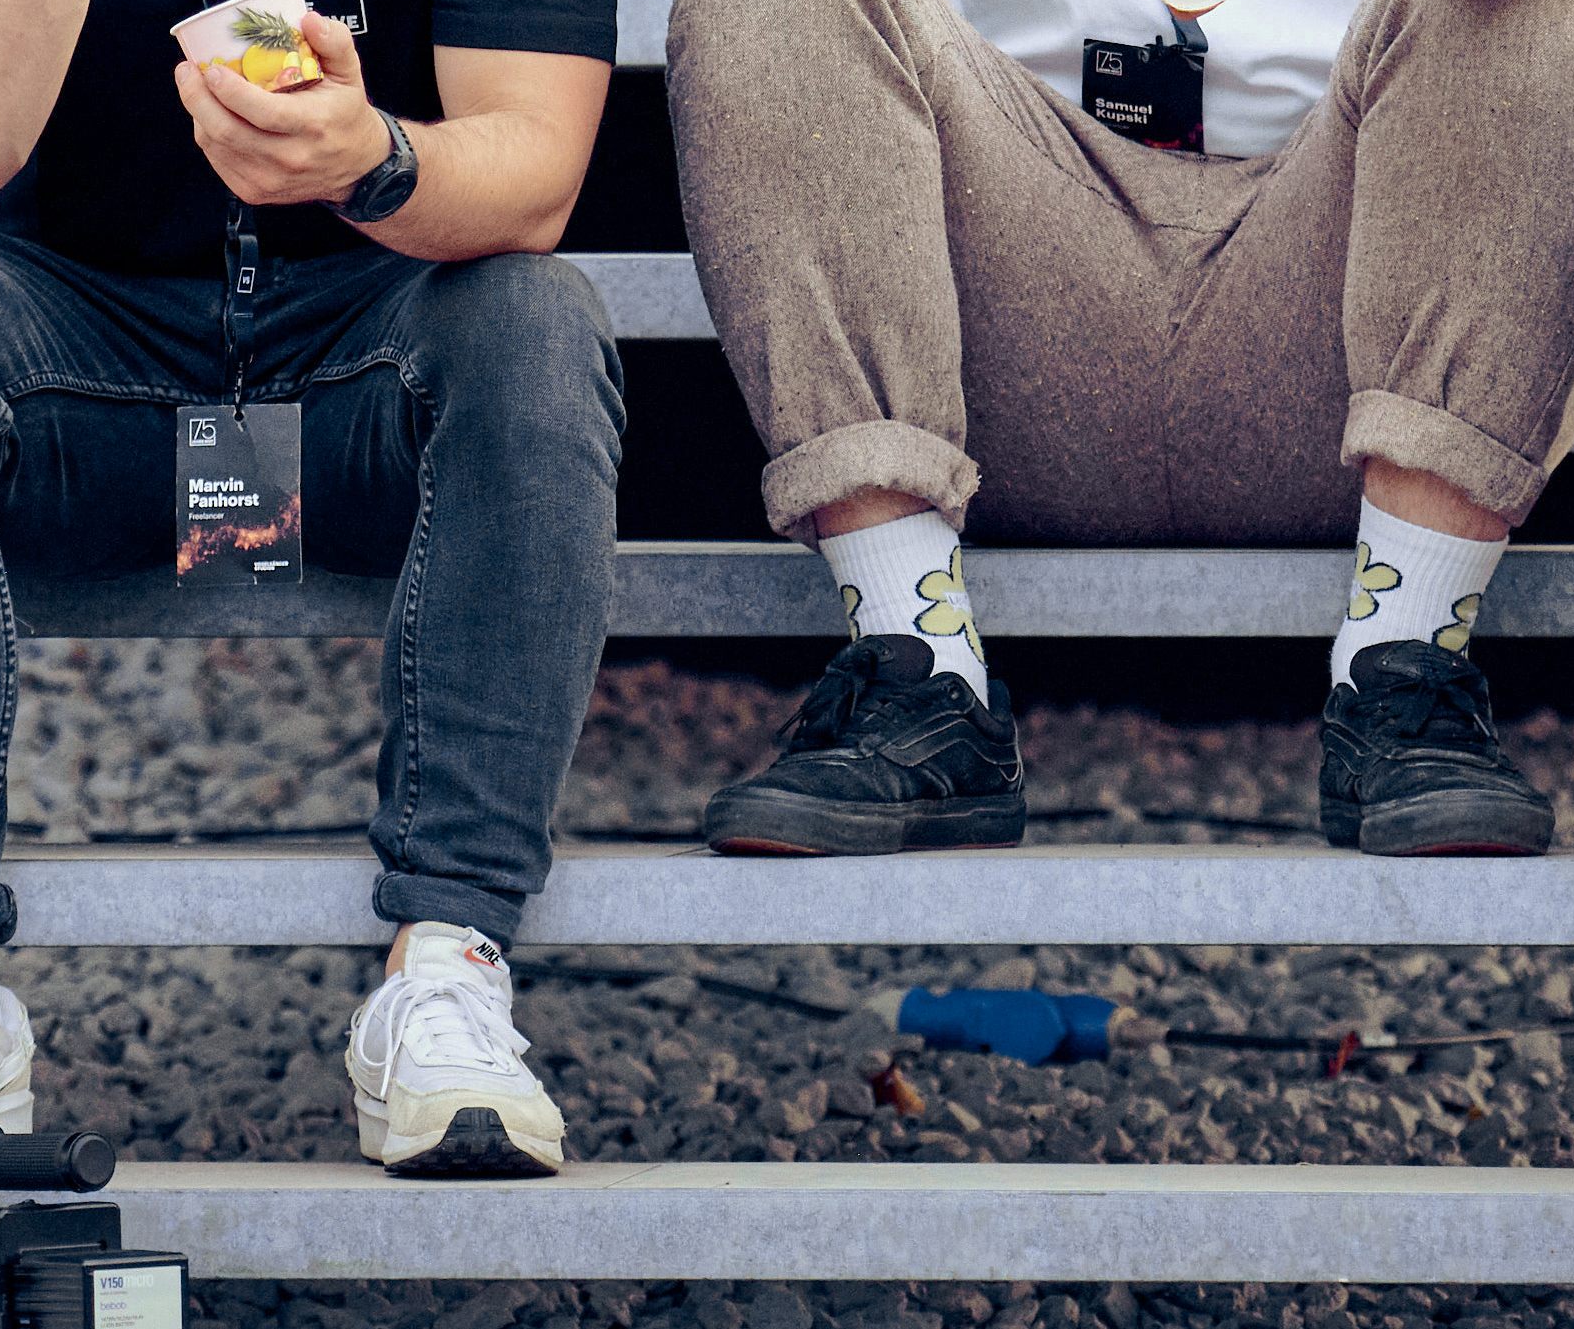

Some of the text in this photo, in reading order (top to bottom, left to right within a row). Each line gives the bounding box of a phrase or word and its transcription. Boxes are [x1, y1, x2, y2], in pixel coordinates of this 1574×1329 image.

[1097, 50, 1122, 72] 75
[1095, 98, 1152, 115] Samuel
[1096, 108, 1148, 124] Kupski
[190, 418, 216, 440] 75
[189, 477, 244, 493] Marvin
[189, 493, 259, 508] Panhorst
[188, 512, 224, 520] Freelancer
[475, 941, 501, 966] NIKE
[100, 1276, 124, 1289] V150
